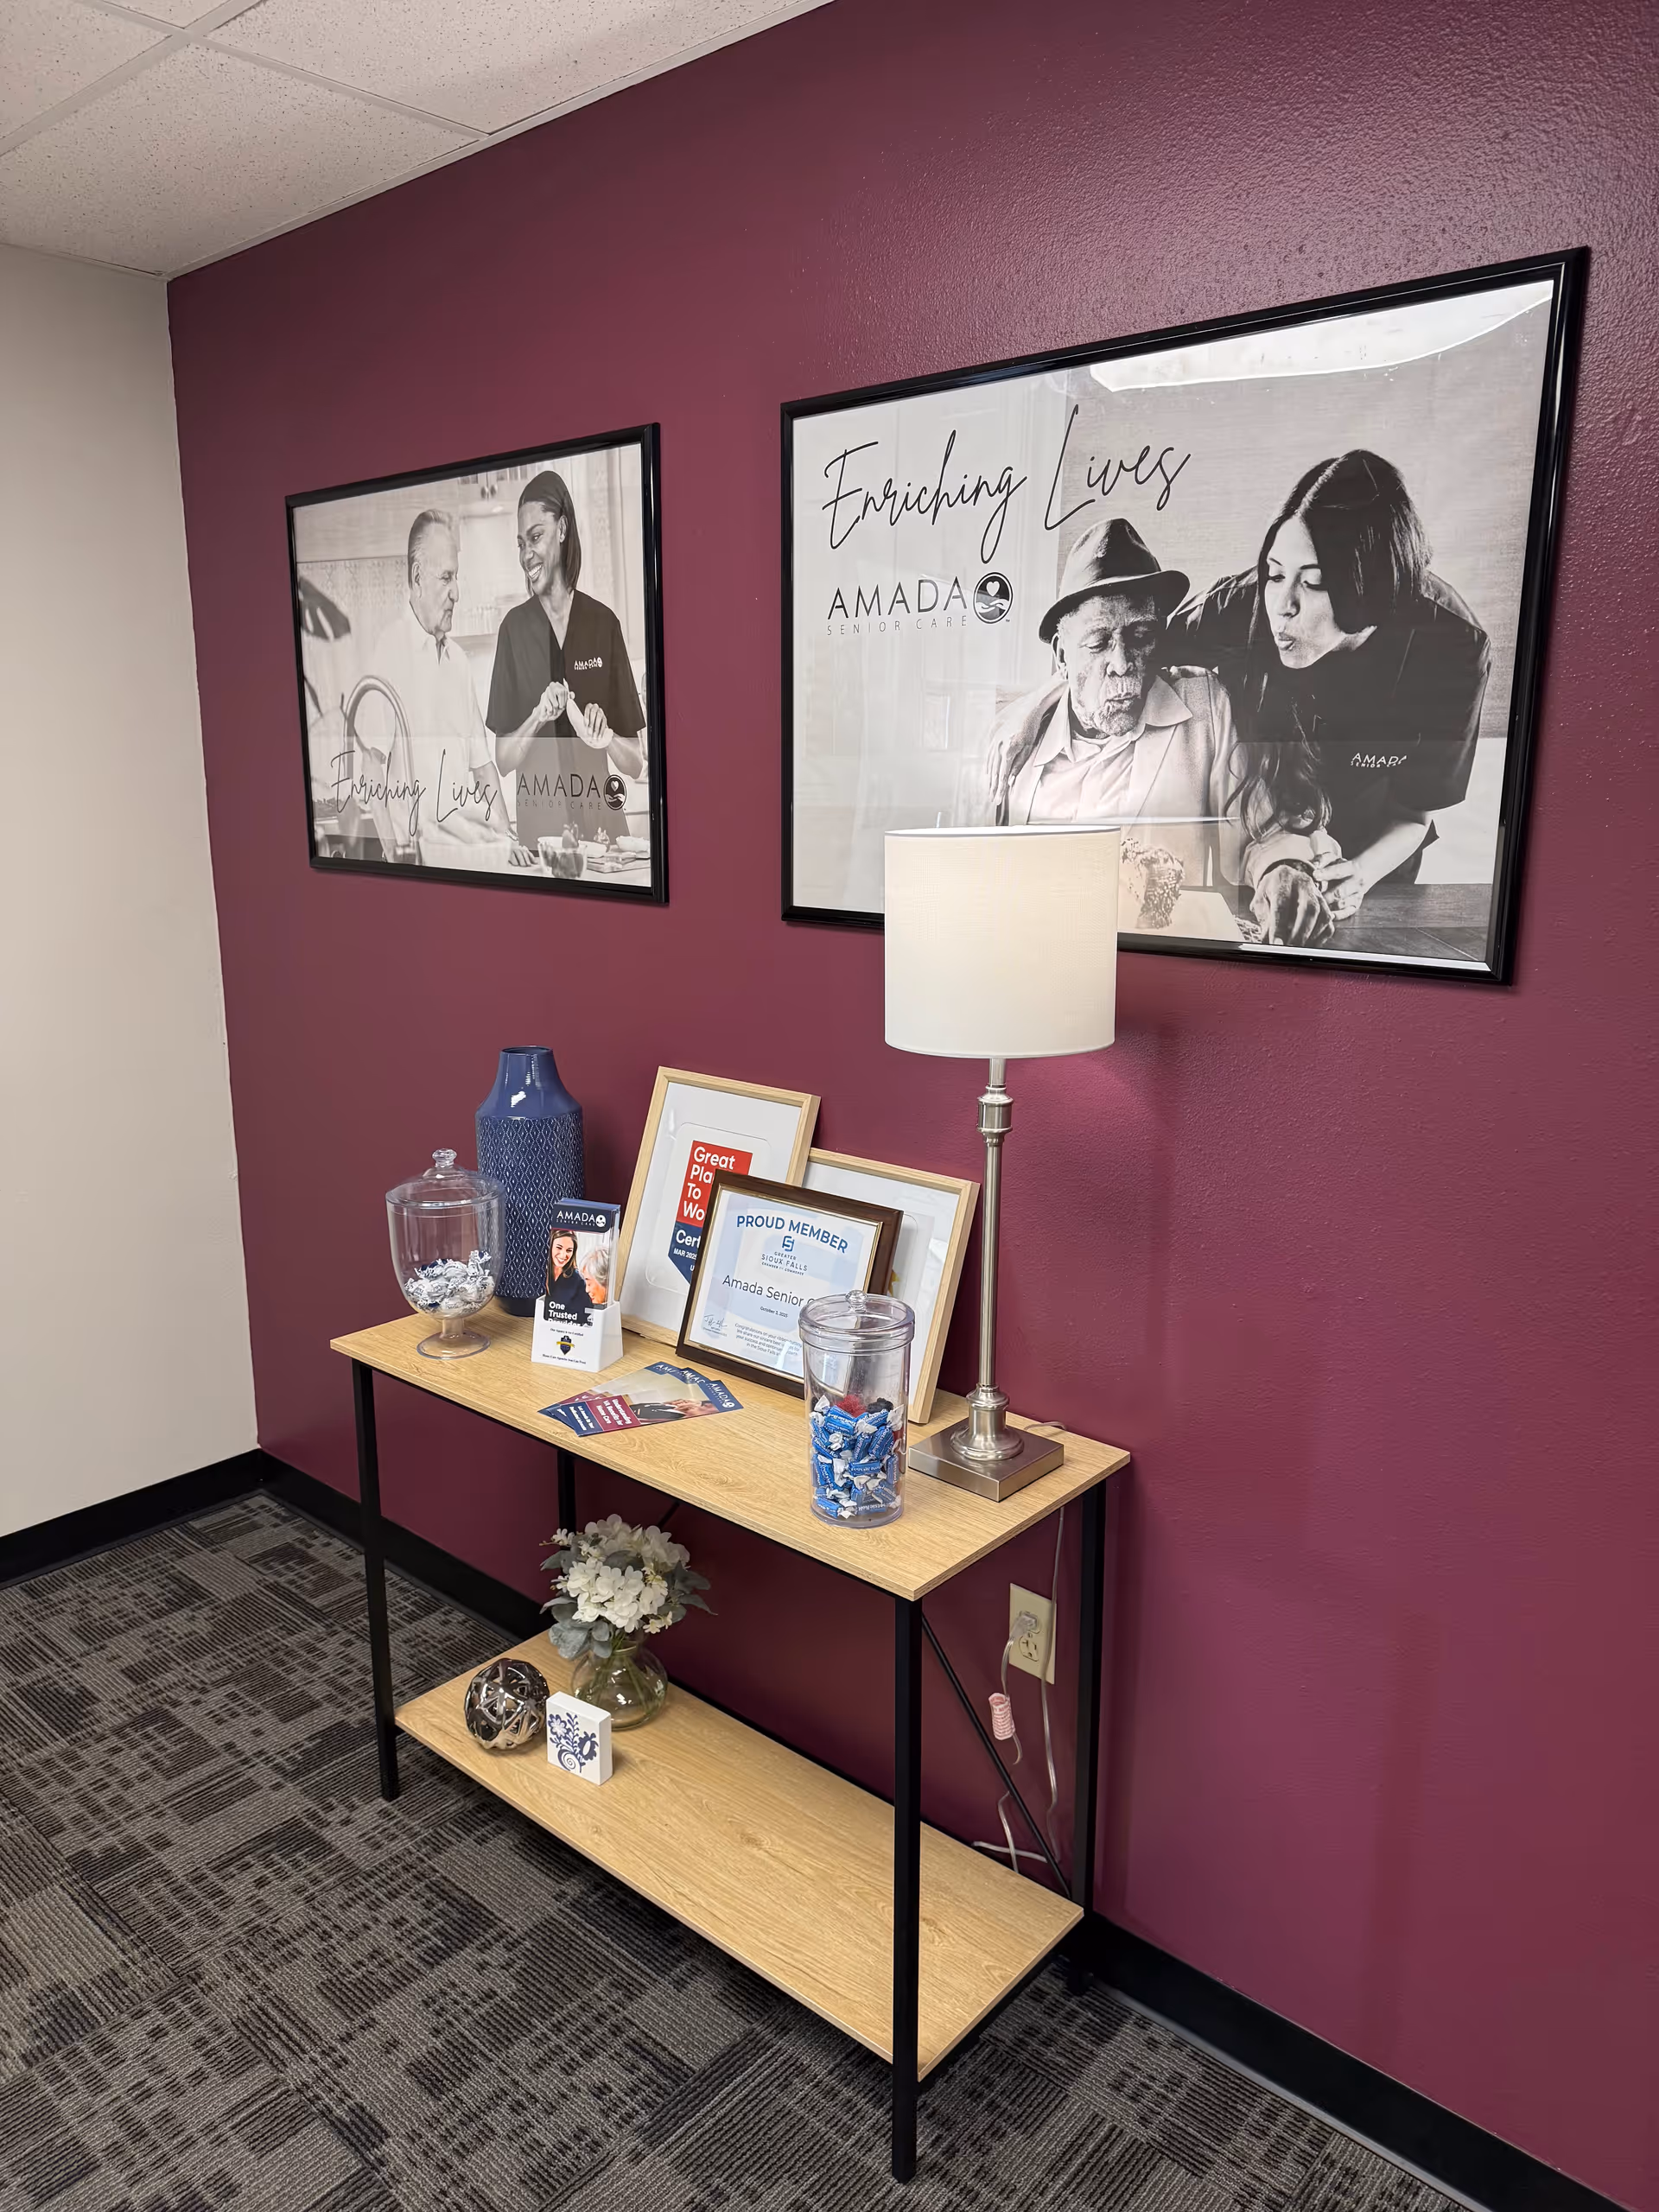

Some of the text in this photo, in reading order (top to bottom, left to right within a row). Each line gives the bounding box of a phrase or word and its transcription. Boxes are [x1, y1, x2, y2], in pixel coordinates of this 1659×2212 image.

[822, 404, 1192, 563] Enriching Lives
[827, 575, 968, 620] AMADA
[827, 614, 968, 636] SENIOR CARE
[331, 748, 498, 837] Enriching Lives
[517, 773, 601, 798] AMADA
[517, 799, 602, 810] SENIOR CARE
[693, 1146, 735, 1170] Great
[687, 1182, 702, 1199] To
[556, 1210, 595, 1223] AMADA
[736, 1215, 849, 1253] PROUD MEMBER
[673, 1248, 686, 1256] MAR
[774, 1251, 797, 1260] GREATER
[761, 1254, 808, 1271] SIOUX FALLS
[722, 1274, 804, 1306] Amada Senior
[549, 1301, 565, 1310] One
[760, 1306, 775, 1314] October
[548, 1310, 577, 1320] Trusted
[595, 1405, 612, 1424] Home Care
[606, 1405, 620, 1421] Benefits
[612, 1399, 632, 1424] Understanding
